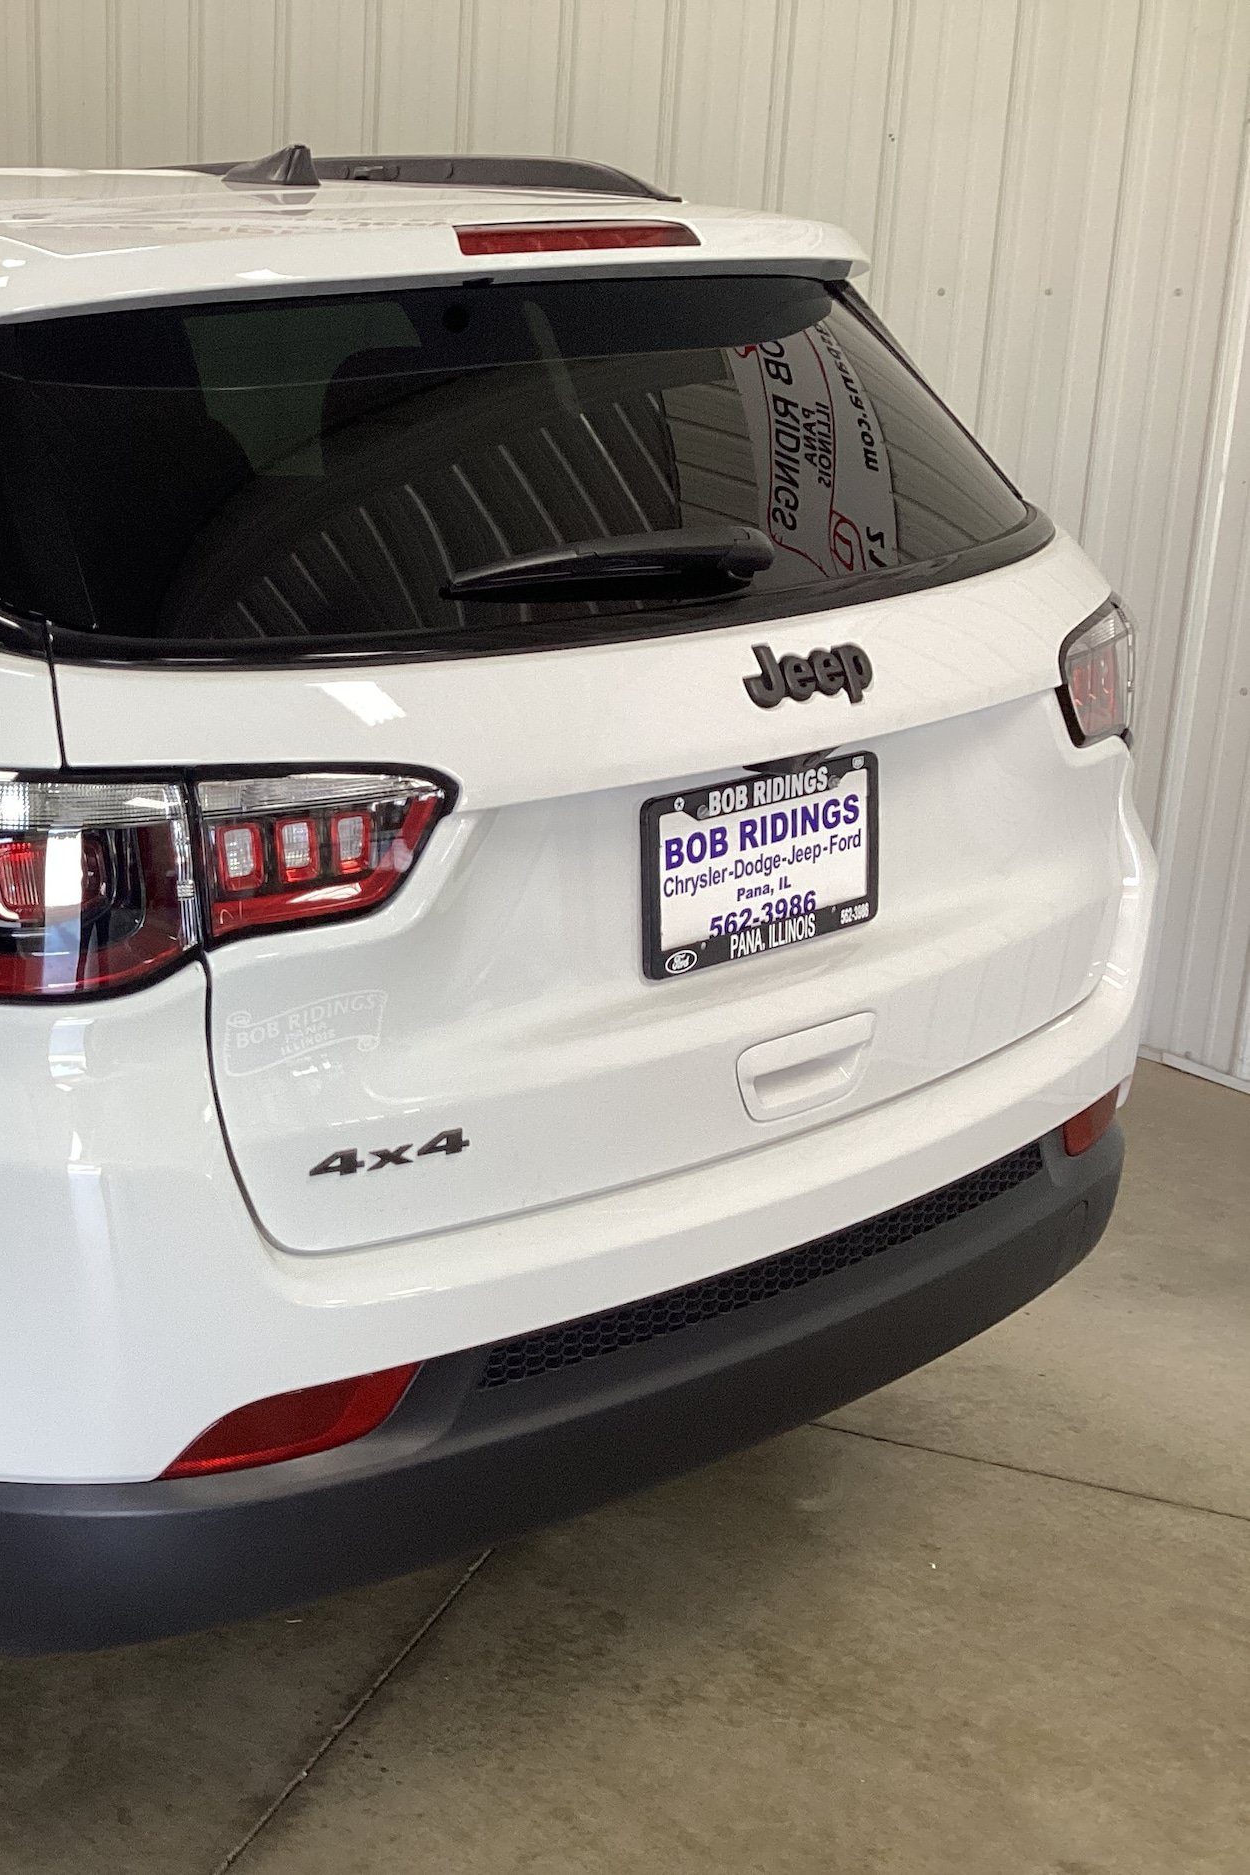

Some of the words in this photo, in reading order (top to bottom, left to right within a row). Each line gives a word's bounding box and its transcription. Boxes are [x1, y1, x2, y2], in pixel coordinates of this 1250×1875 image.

[742, 642, 873, 709] Jeep
[708, 785, 748, 817] BOB
[753, 766, 828, 807] RIDINGS
[664, 826, 729, 871] BOB
[739, 793, 860, 851] RIDINGS
[663, 828, 862, 898] Chrysler-Dodge-Jeep-Ford
[709, 890, 817, 938] 562-3986
[736, 882, 774, 902] Pana,
[779, 876, 792, 891] IL
[768, 913, 817, 949] ILLINOIS
[236, 1021, 280, 1049] BOB
[288, 993, 378, 1031] RIDINGS
[309, 1127, 470, 1177] 4x4
